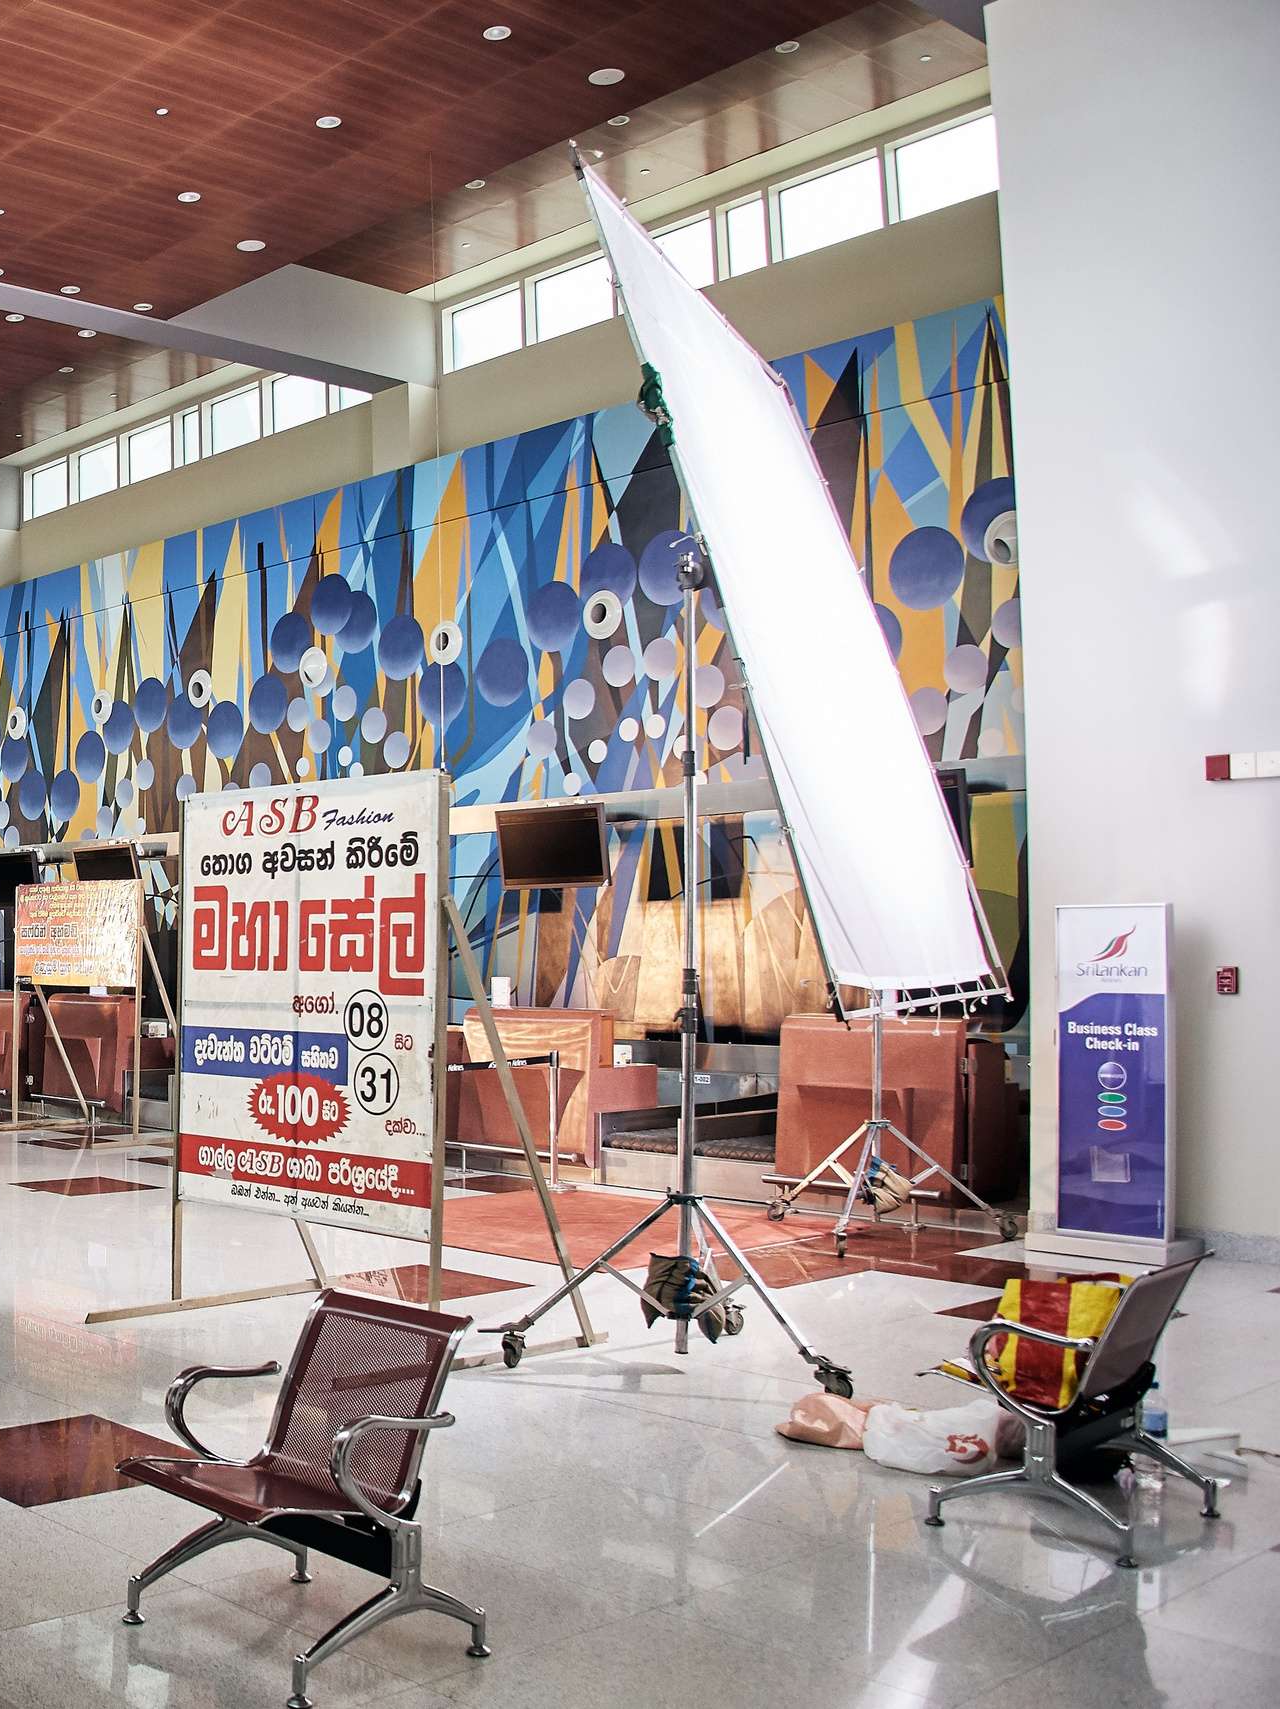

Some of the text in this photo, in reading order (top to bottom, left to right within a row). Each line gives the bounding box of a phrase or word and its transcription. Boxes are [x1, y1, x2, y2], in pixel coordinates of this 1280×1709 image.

[221, 794, 395, 837] ASB Fashion
[200, 831, 419, 879] තොග අවසන් කිරීමේ
[1076, 963, 1148, 977] SriLankan
[348, 1002, 384, 1039] 08
[394, 1034, 414, 1051] සිට
[1067, 1022, 1158, 1037] Business Class
[1085, 1037, 1140, 1051] Check-in
[194, 1033, 339, 1069] දැවැන්ත වට්ටම් සහිතව
[360, 1066, 392, 1104] 31
[322, 1100, 339, 1122] සිට
[198, 1143, 235, 1172] ගාල්ල
[237, 1149, 284, 1178] ASB
